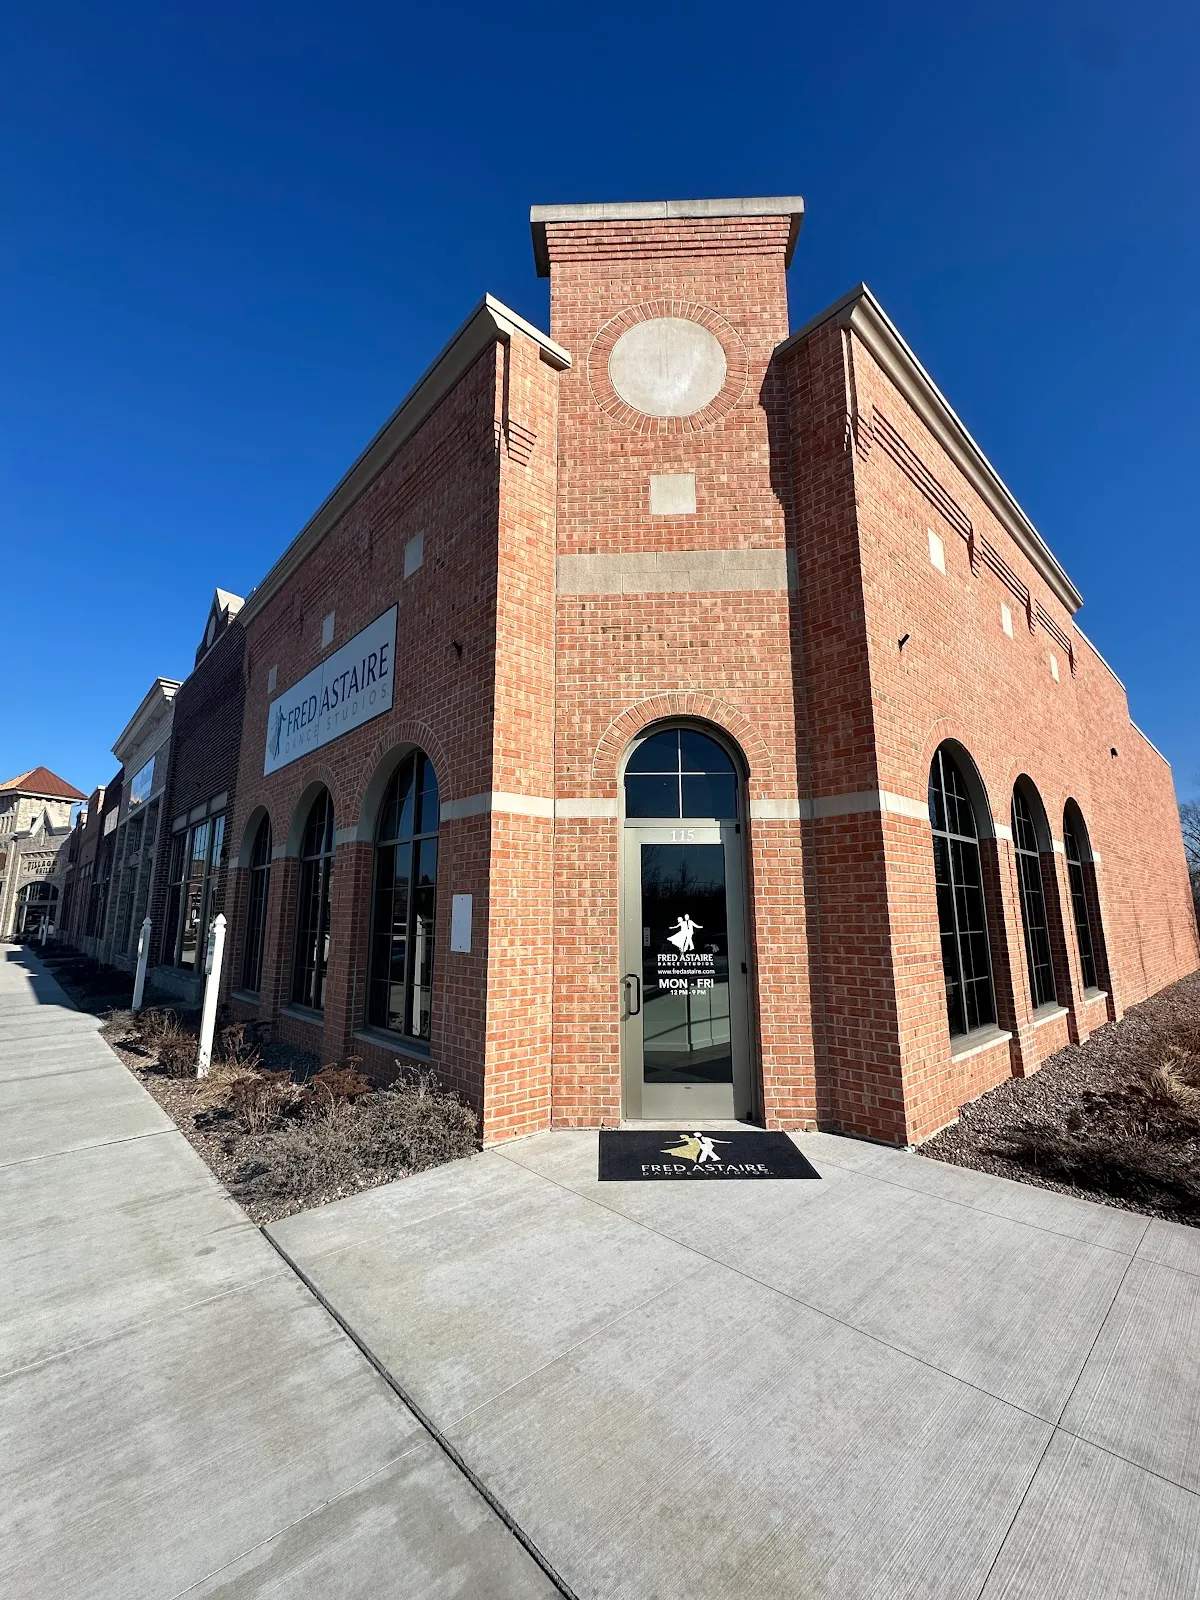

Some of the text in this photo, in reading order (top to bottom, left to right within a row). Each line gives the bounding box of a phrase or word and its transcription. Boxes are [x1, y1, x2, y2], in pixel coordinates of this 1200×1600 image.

[286, 642, 389, 737] FRED ASTAIRE
[285, 682, 388, 754] DANCE STUDIOS
[671, 829, 695, 842] 115
[657, 953, 714, 962] FRED ASTAIRE
[657, 967, 716, 975] www.fredastaire.com
[659, 978, 688, 989] MON
[697, 978, 714, 989] FRI
[641, 1164, 769, 1172] FRED ASTAIRE
